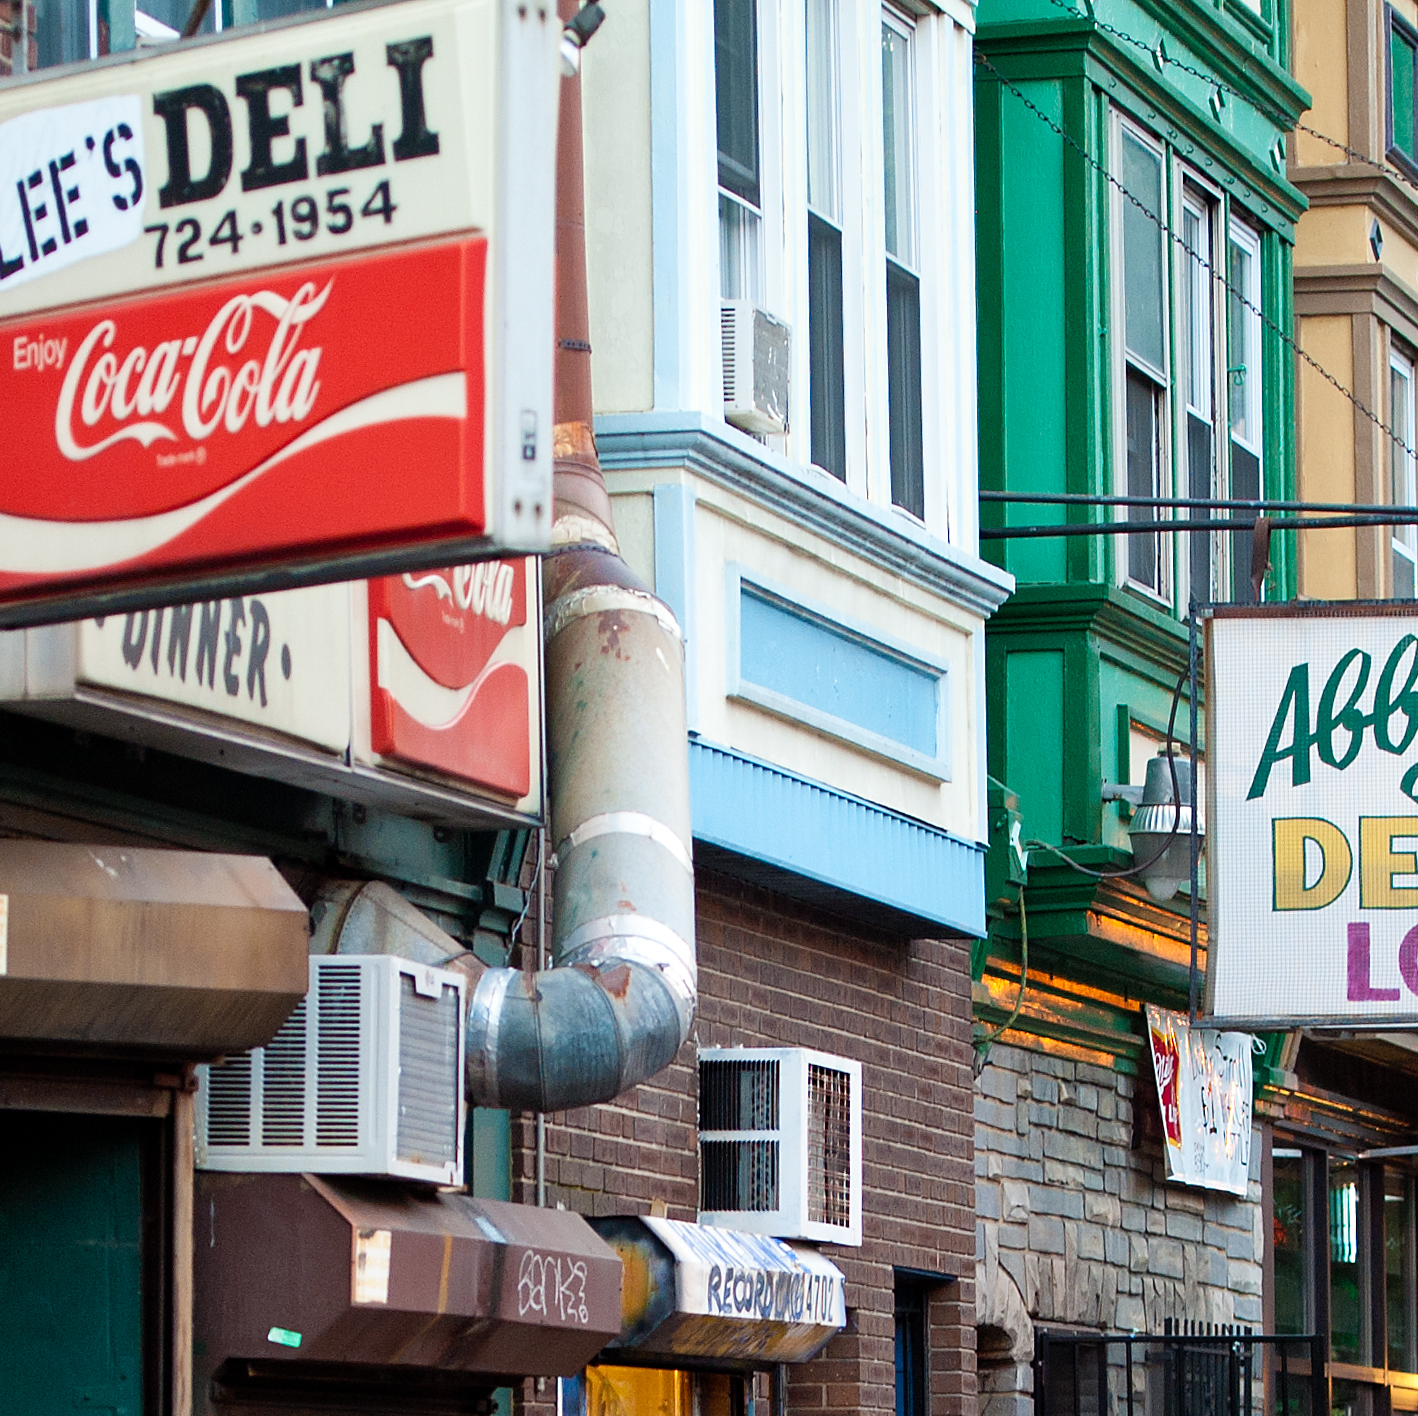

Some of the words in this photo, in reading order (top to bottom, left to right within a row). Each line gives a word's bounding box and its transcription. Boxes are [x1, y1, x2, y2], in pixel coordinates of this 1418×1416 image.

[153, 36, 440, 209] DELI
[13, 334, 67, 371] Enjoy
[55, 275, 337, 461] Coca-Cola
